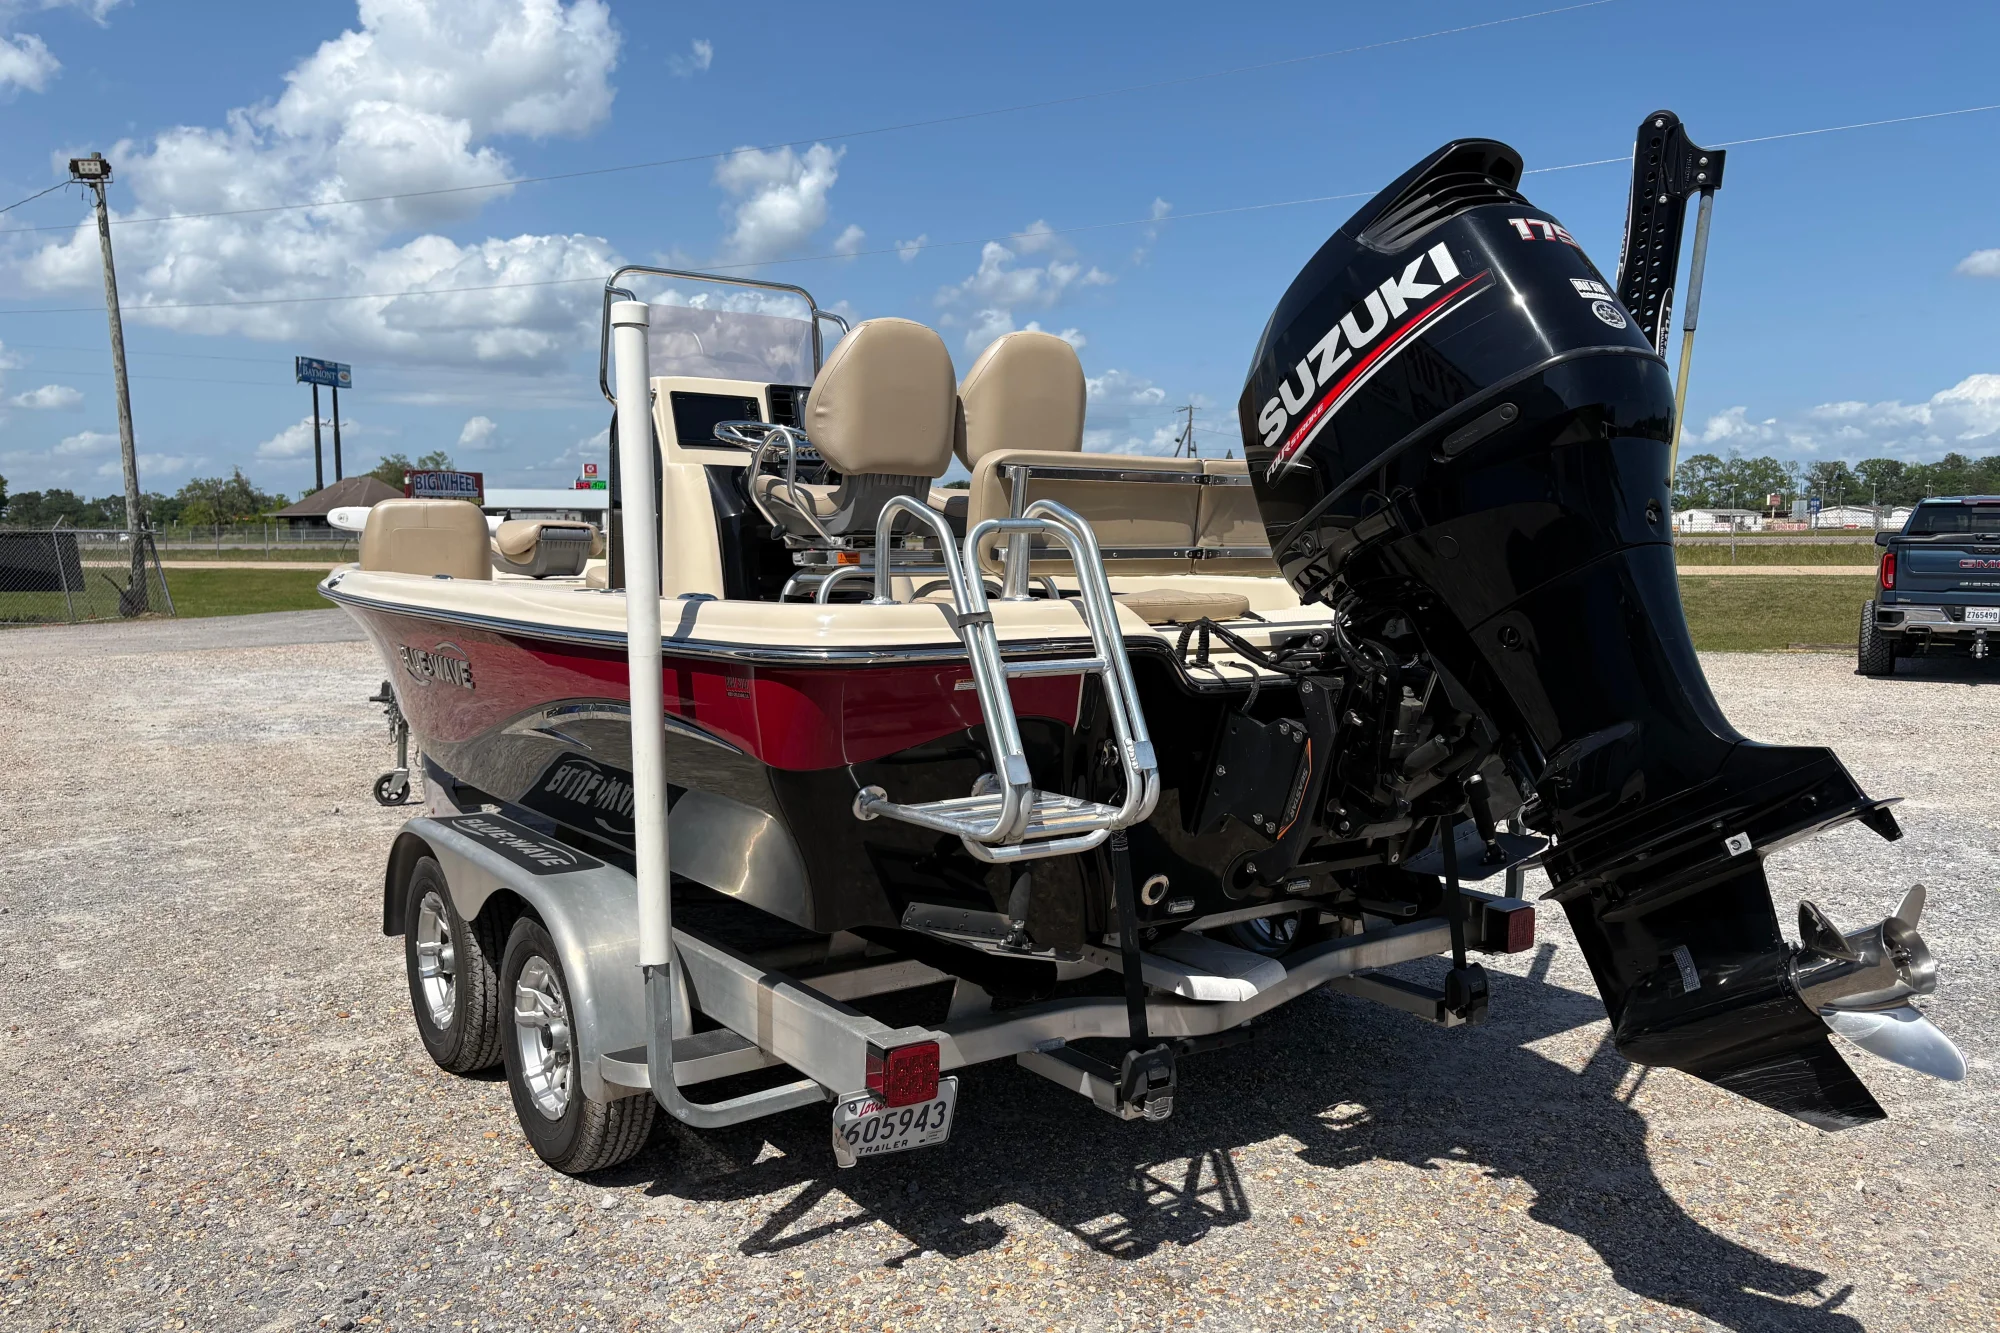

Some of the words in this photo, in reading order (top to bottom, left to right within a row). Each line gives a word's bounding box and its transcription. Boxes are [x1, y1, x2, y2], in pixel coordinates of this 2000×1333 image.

[1508, 218, 1580, 249] 175
[1258, 241, 1460, 448] SUZUKI
[303, 365, 337, 380] BAYMONT
[415, 473, 437, 491] BIG
[437, 471, 478, 492] WHEEL
[1959, 560, 2000, 569] GM
[400, 644, 433, 677] BLUE
[433, 653, 476, 690] WAVE
[1290, 768, 1308, 818] SEASTAR
[458, 818, 517, 839] BLUE
[505, 839, 571, 867] WAVE
[858, 1139, 909, 1155] TRAILER
